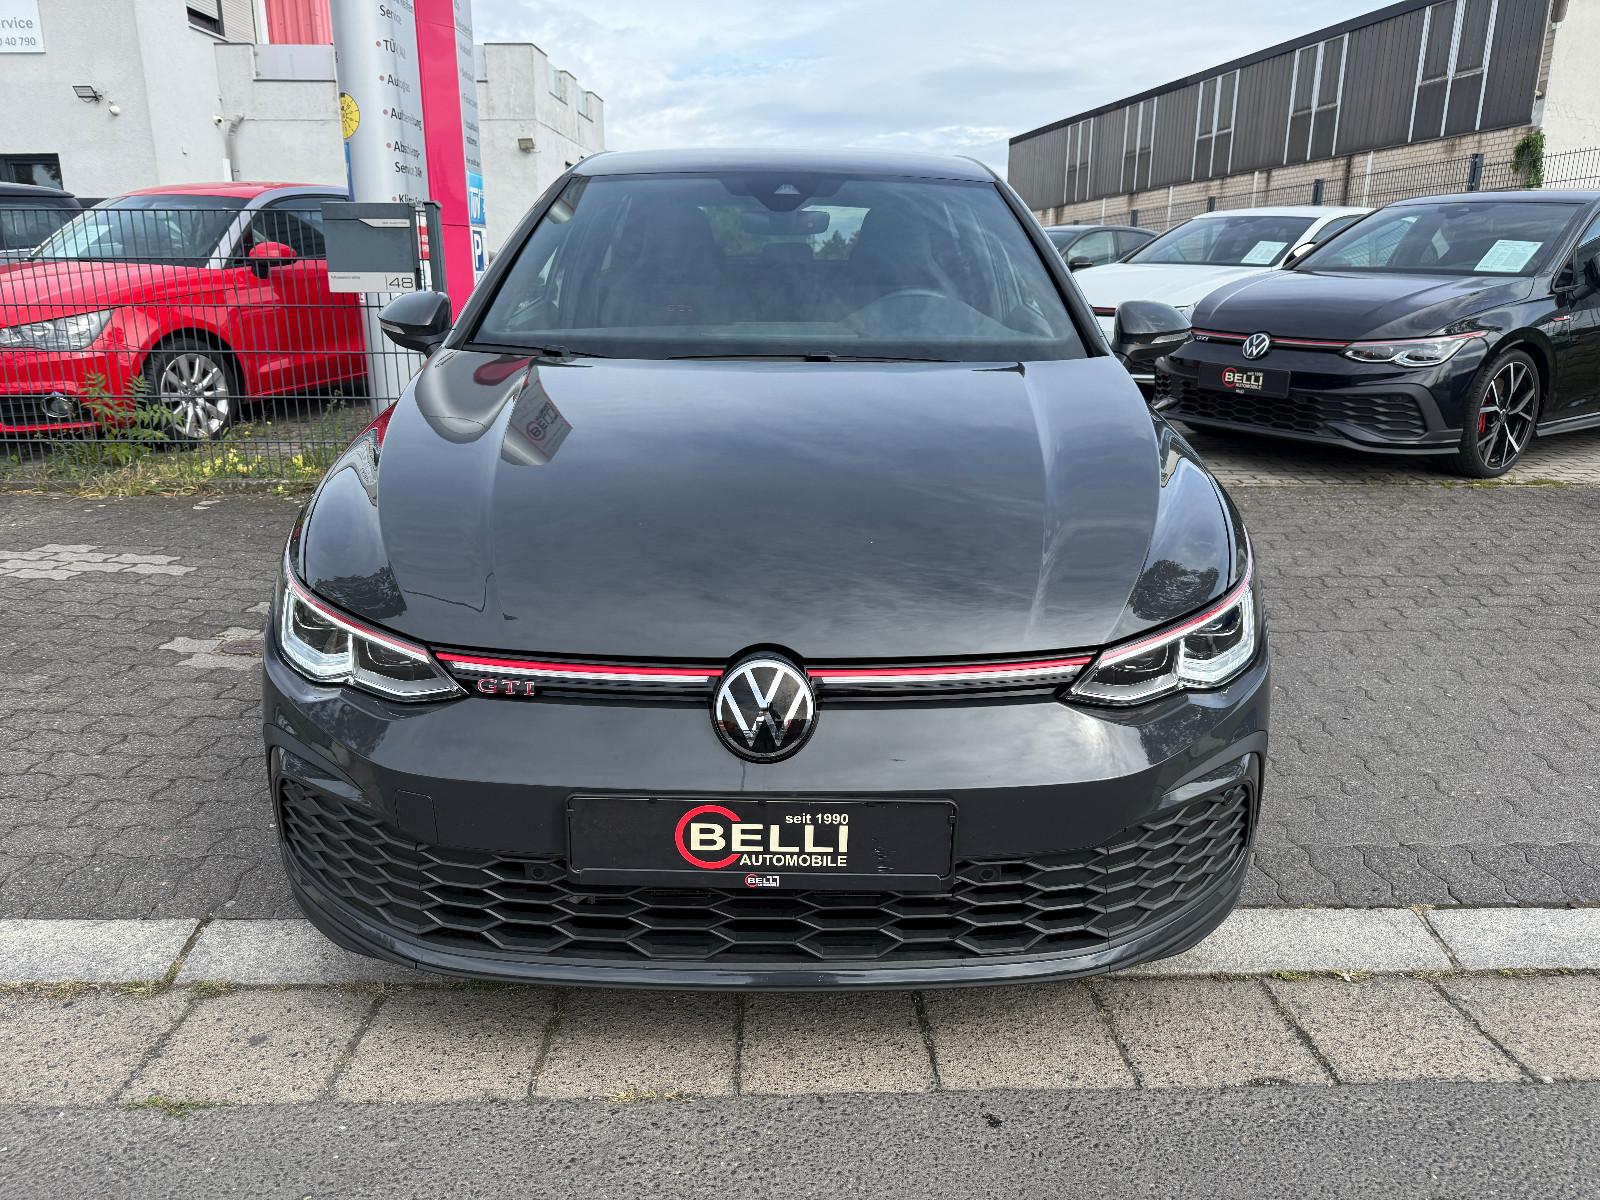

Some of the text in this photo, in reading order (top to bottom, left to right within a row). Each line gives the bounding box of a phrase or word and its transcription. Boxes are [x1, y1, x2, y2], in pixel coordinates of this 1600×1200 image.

[18, 36, 36, 46] 790
[388, 277, 414, 289] 48
[1225, 372, 1263, 385] BELLI
[477, 679, 535, 696] GTI
[785, 813, 849, 825] seit 1990
[690, 823, 849, 853] BELLI
[739, 854, 848, 867] AUTOMOBILE
